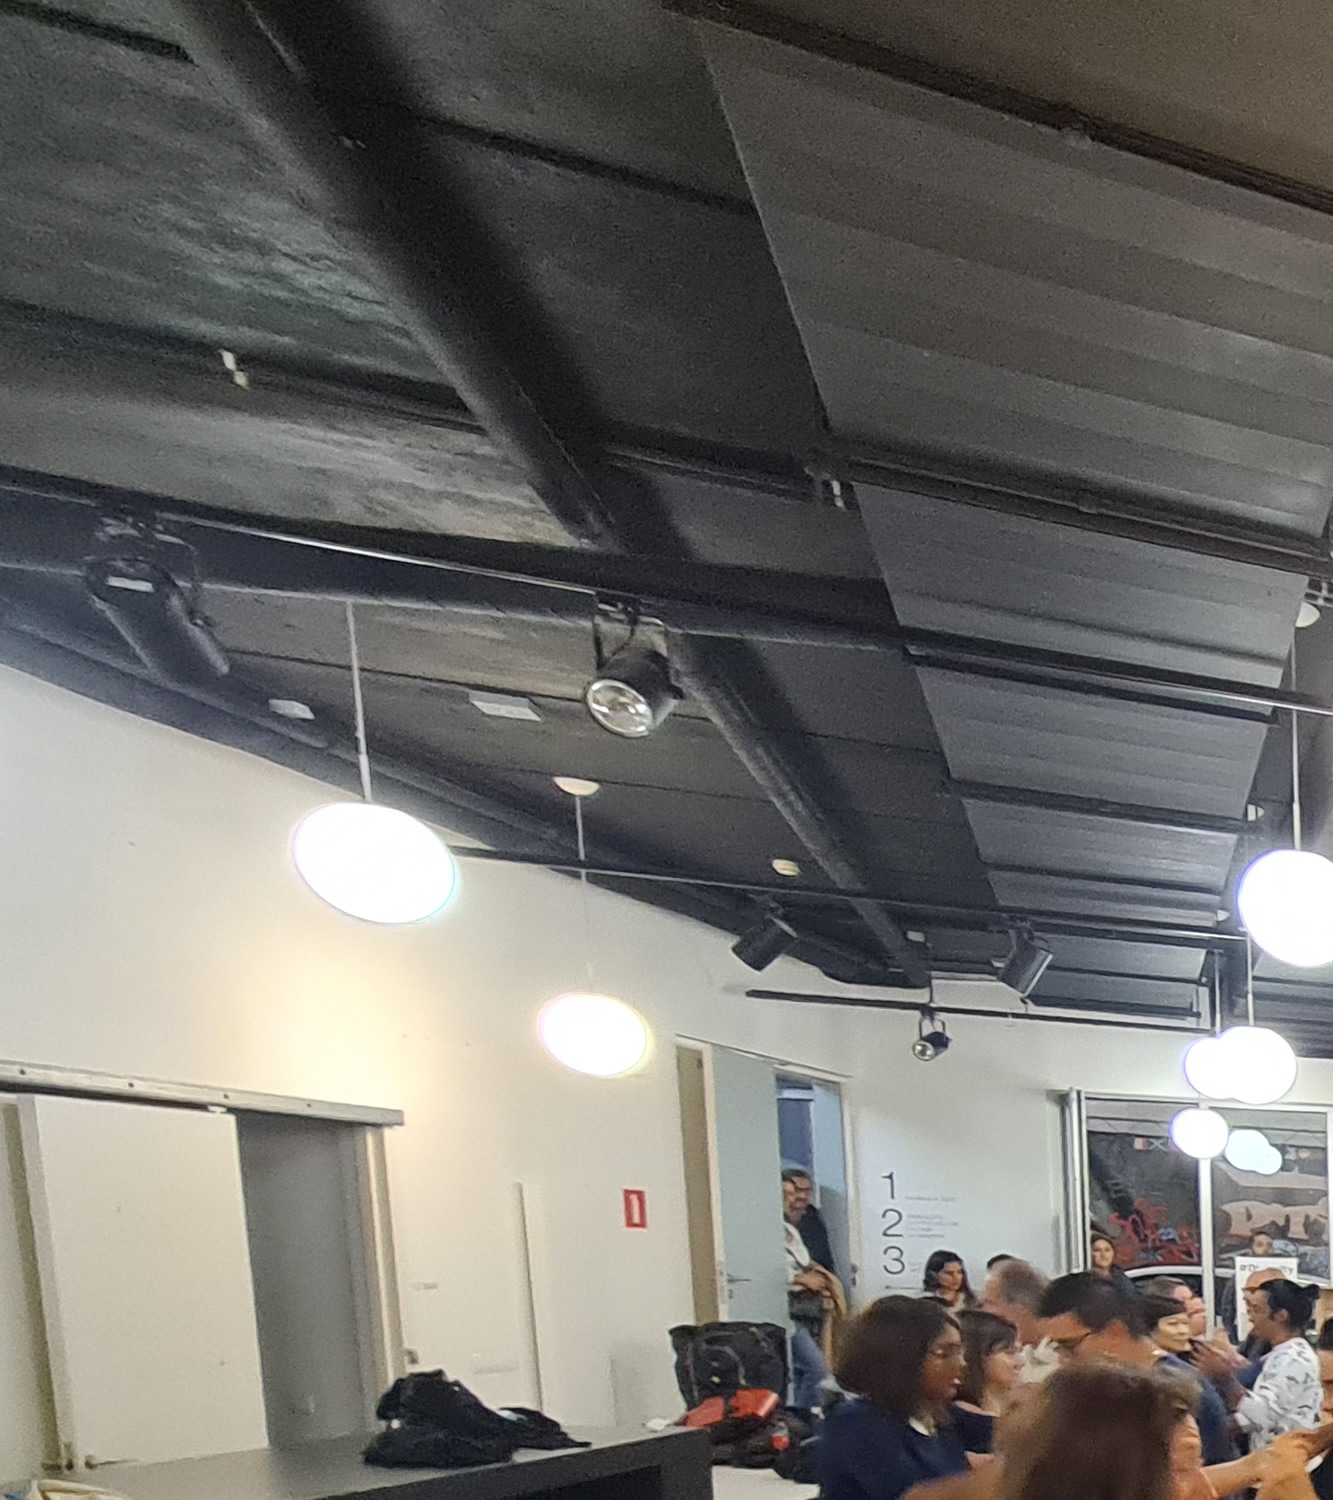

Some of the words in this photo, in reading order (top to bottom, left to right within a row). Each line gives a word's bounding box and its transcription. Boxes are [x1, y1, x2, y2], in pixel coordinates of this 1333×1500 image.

[881, 1171, 895, 1200] 1
[882, 1208, 904, 1238] 2
[883, 1245, 905, 1275] 3
